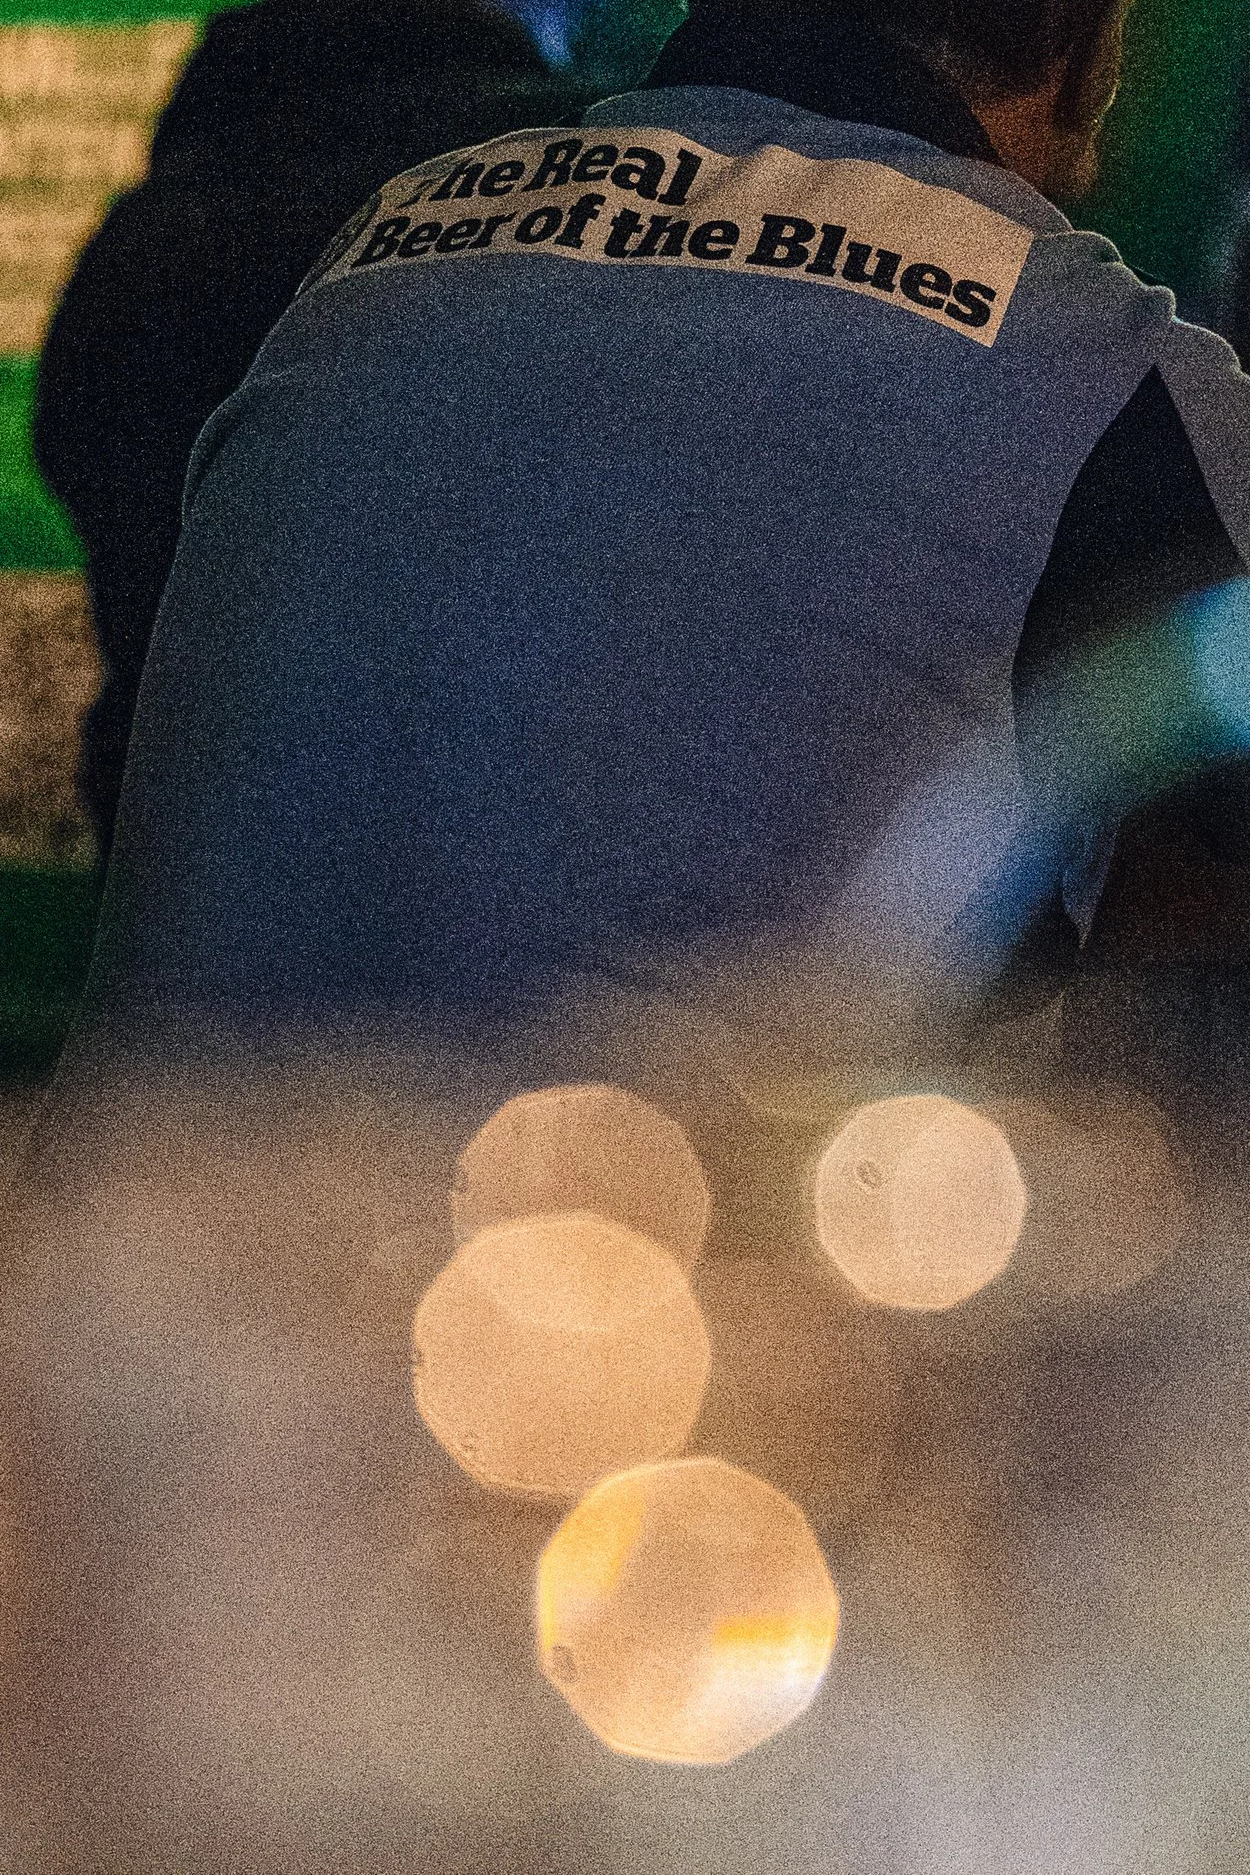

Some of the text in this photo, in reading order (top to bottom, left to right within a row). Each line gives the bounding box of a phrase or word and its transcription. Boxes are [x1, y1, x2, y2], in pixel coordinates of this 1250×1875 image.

[521, 138, 702, 207] Real
[351, 193, 996, 328] Beer of the Blues
